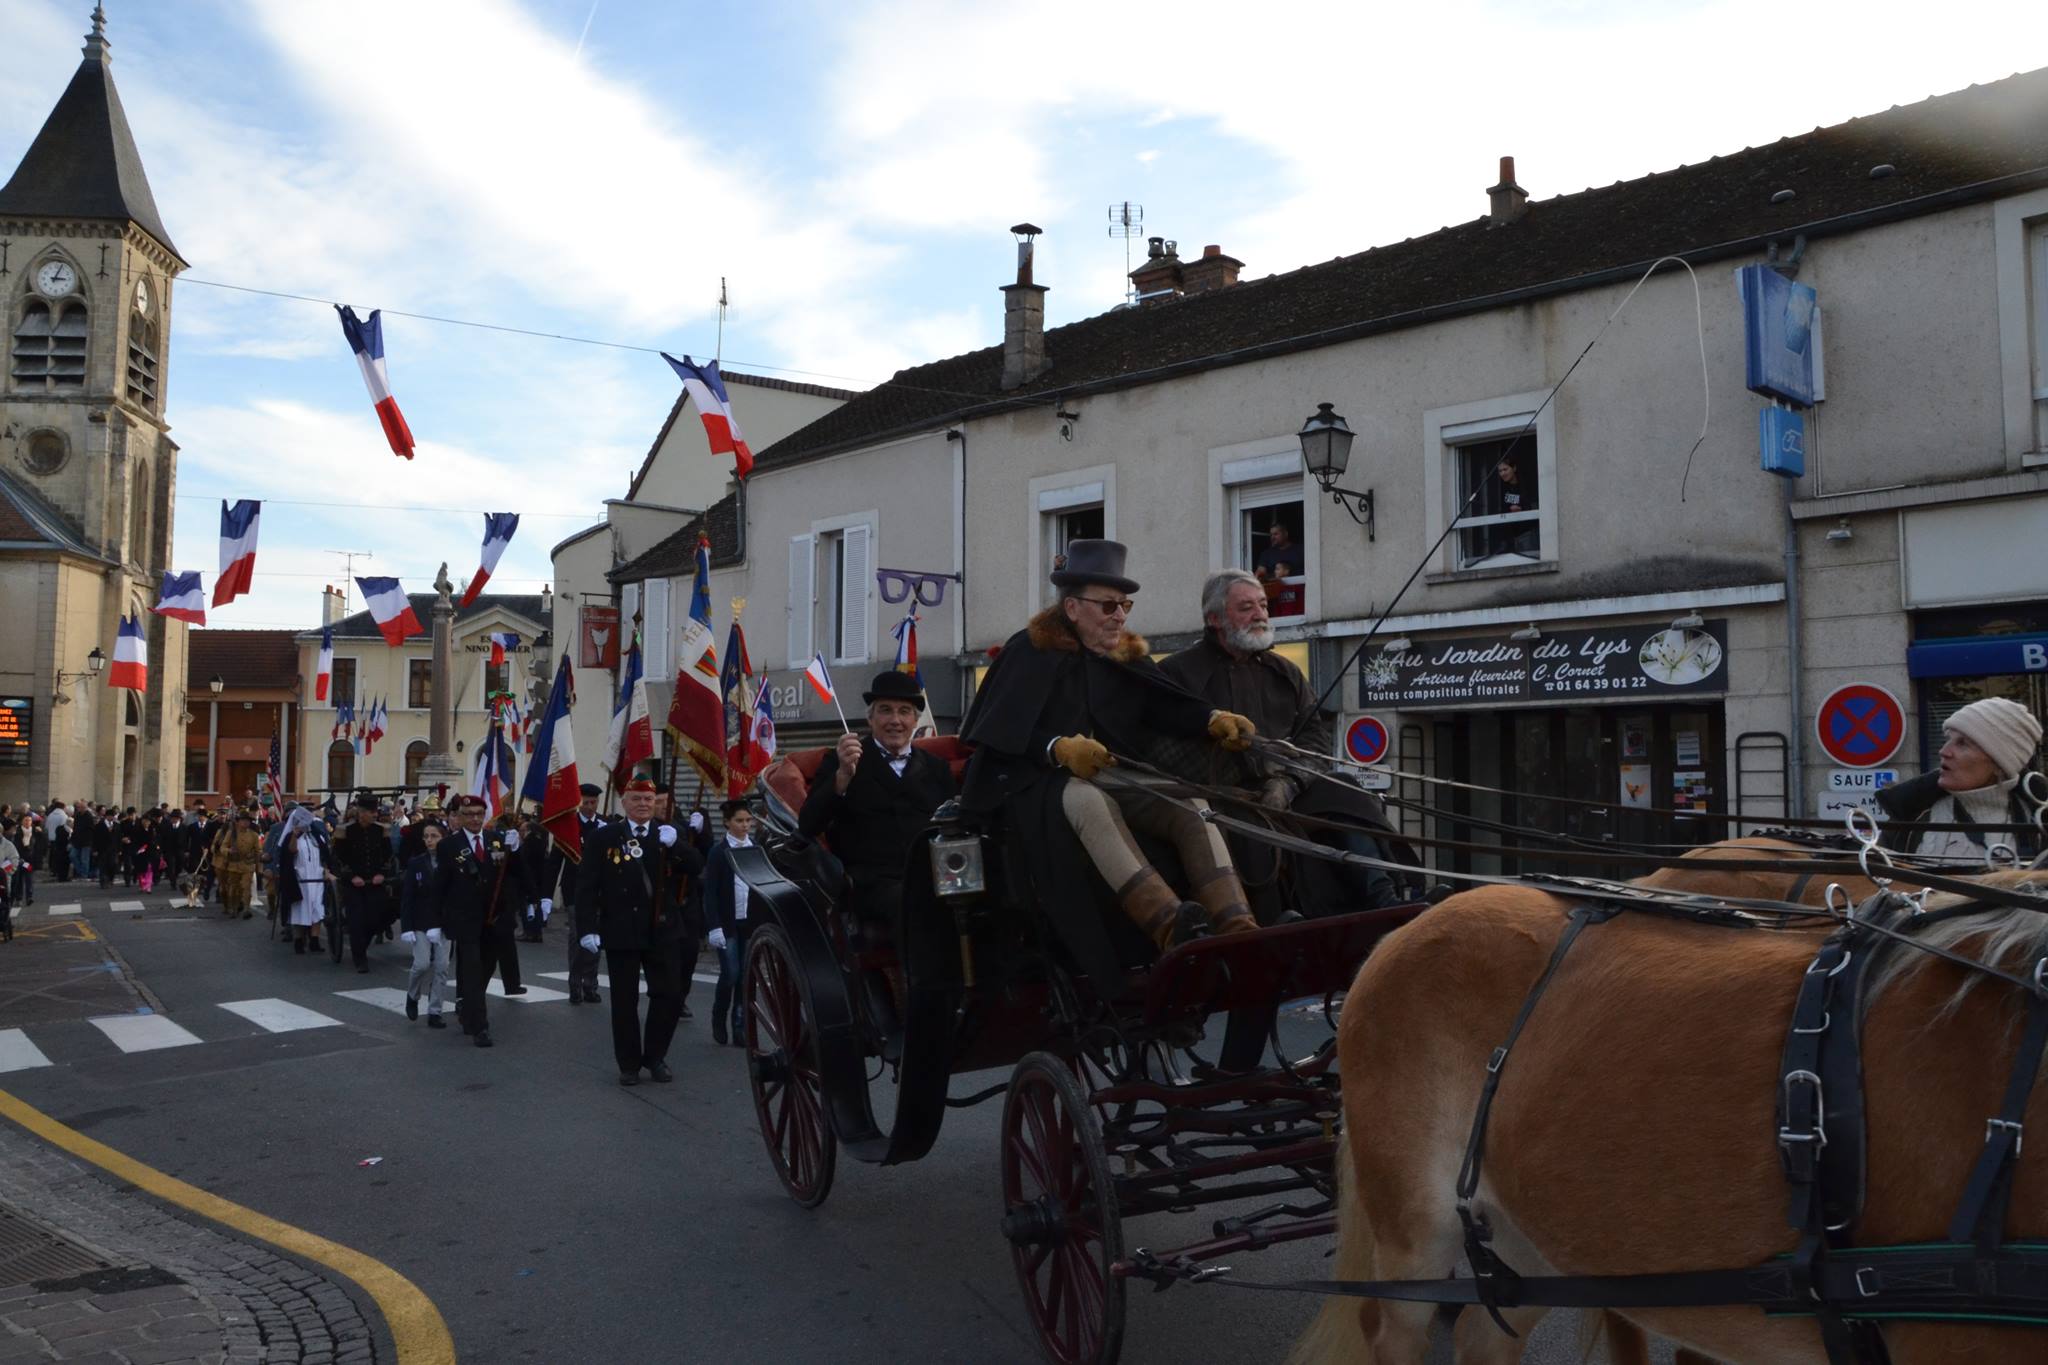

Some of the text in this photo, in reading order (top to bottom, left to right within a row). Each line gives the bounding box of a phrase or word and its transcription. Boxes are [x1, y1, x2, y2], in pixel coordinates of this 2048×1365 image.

[1389, 636, 1632, 668] Au Jardin du Lys
[1409, 662, 1607, 687] Artisan fleuriste C. Cornet
[1556, 677, 1647, 691] 01 64 39 01 22
[1367, 684, 1521, 701] Toutes compositions florales
[1834, 774, 1873, 786] SAUF
[1861, 797, 1877, 806] AM
